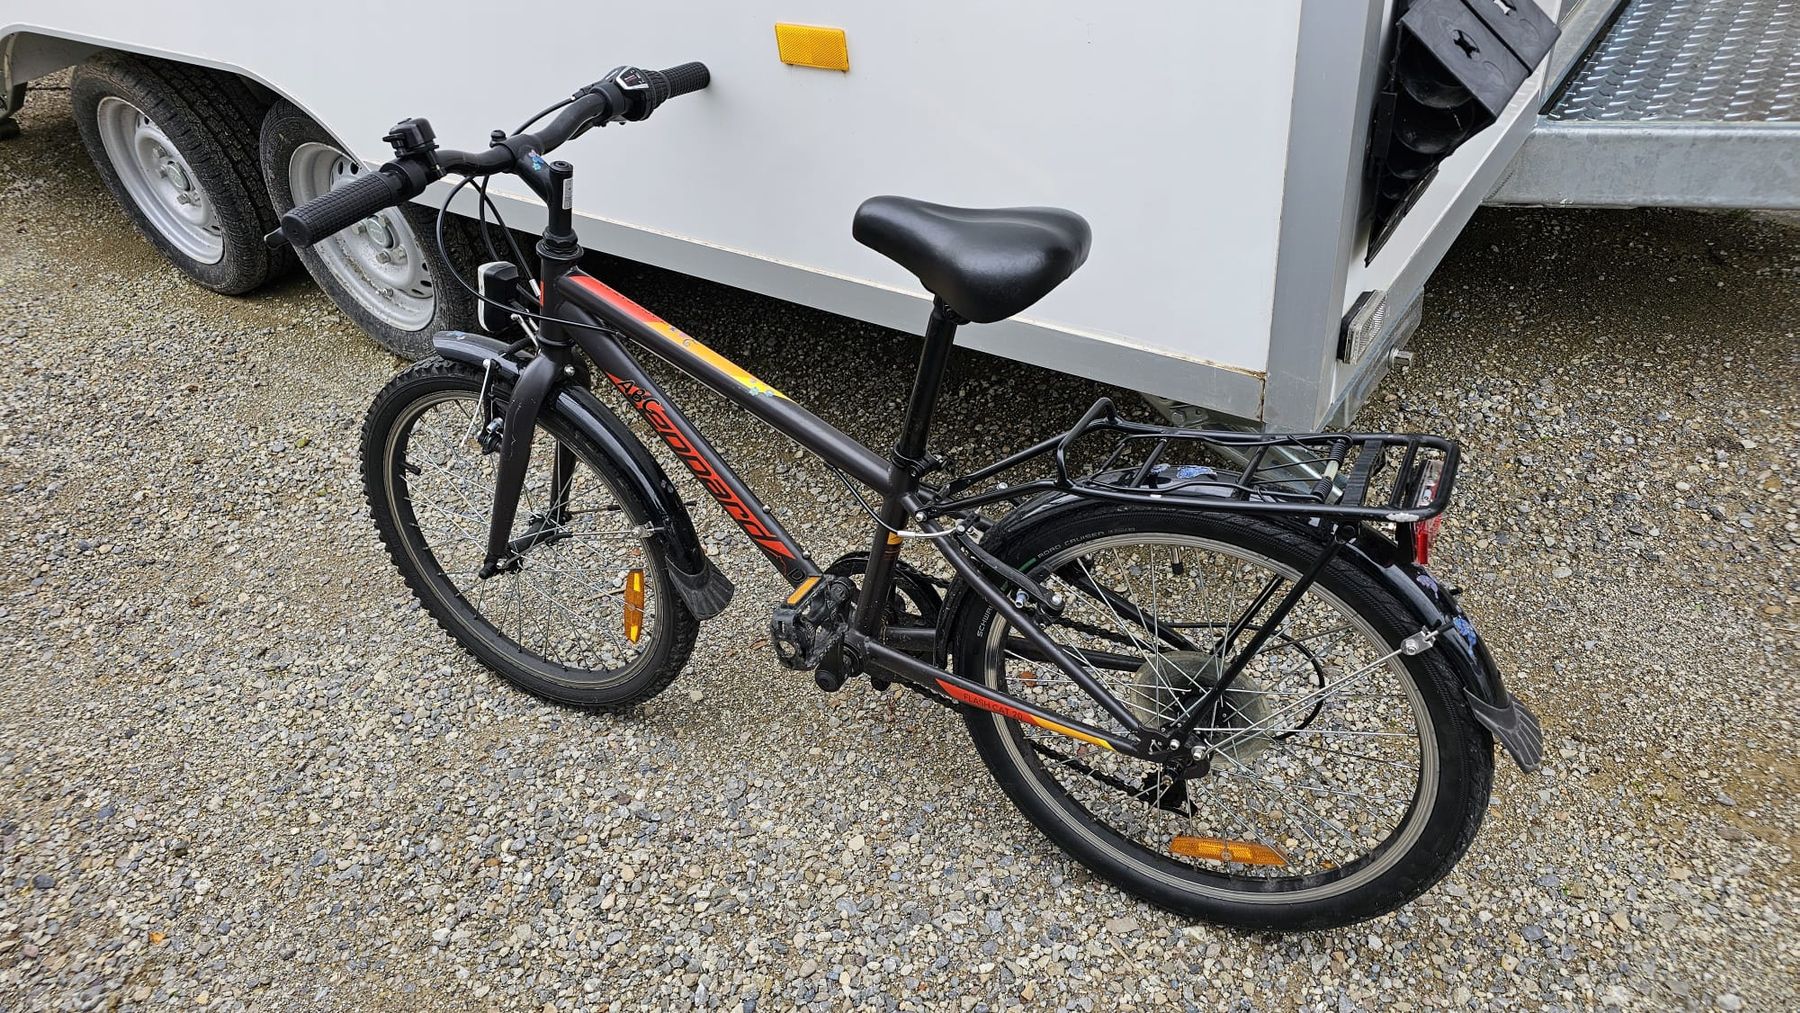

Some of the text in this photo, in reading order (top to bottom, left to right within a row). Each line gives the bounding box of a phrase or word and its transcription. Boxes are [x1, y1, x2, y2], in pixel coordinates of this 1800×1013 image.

[617, 379, 661, 414] ABC
[636, 402, 781, 542] eopard
[963, 692, 1024, 721] FLASH CAT 20
